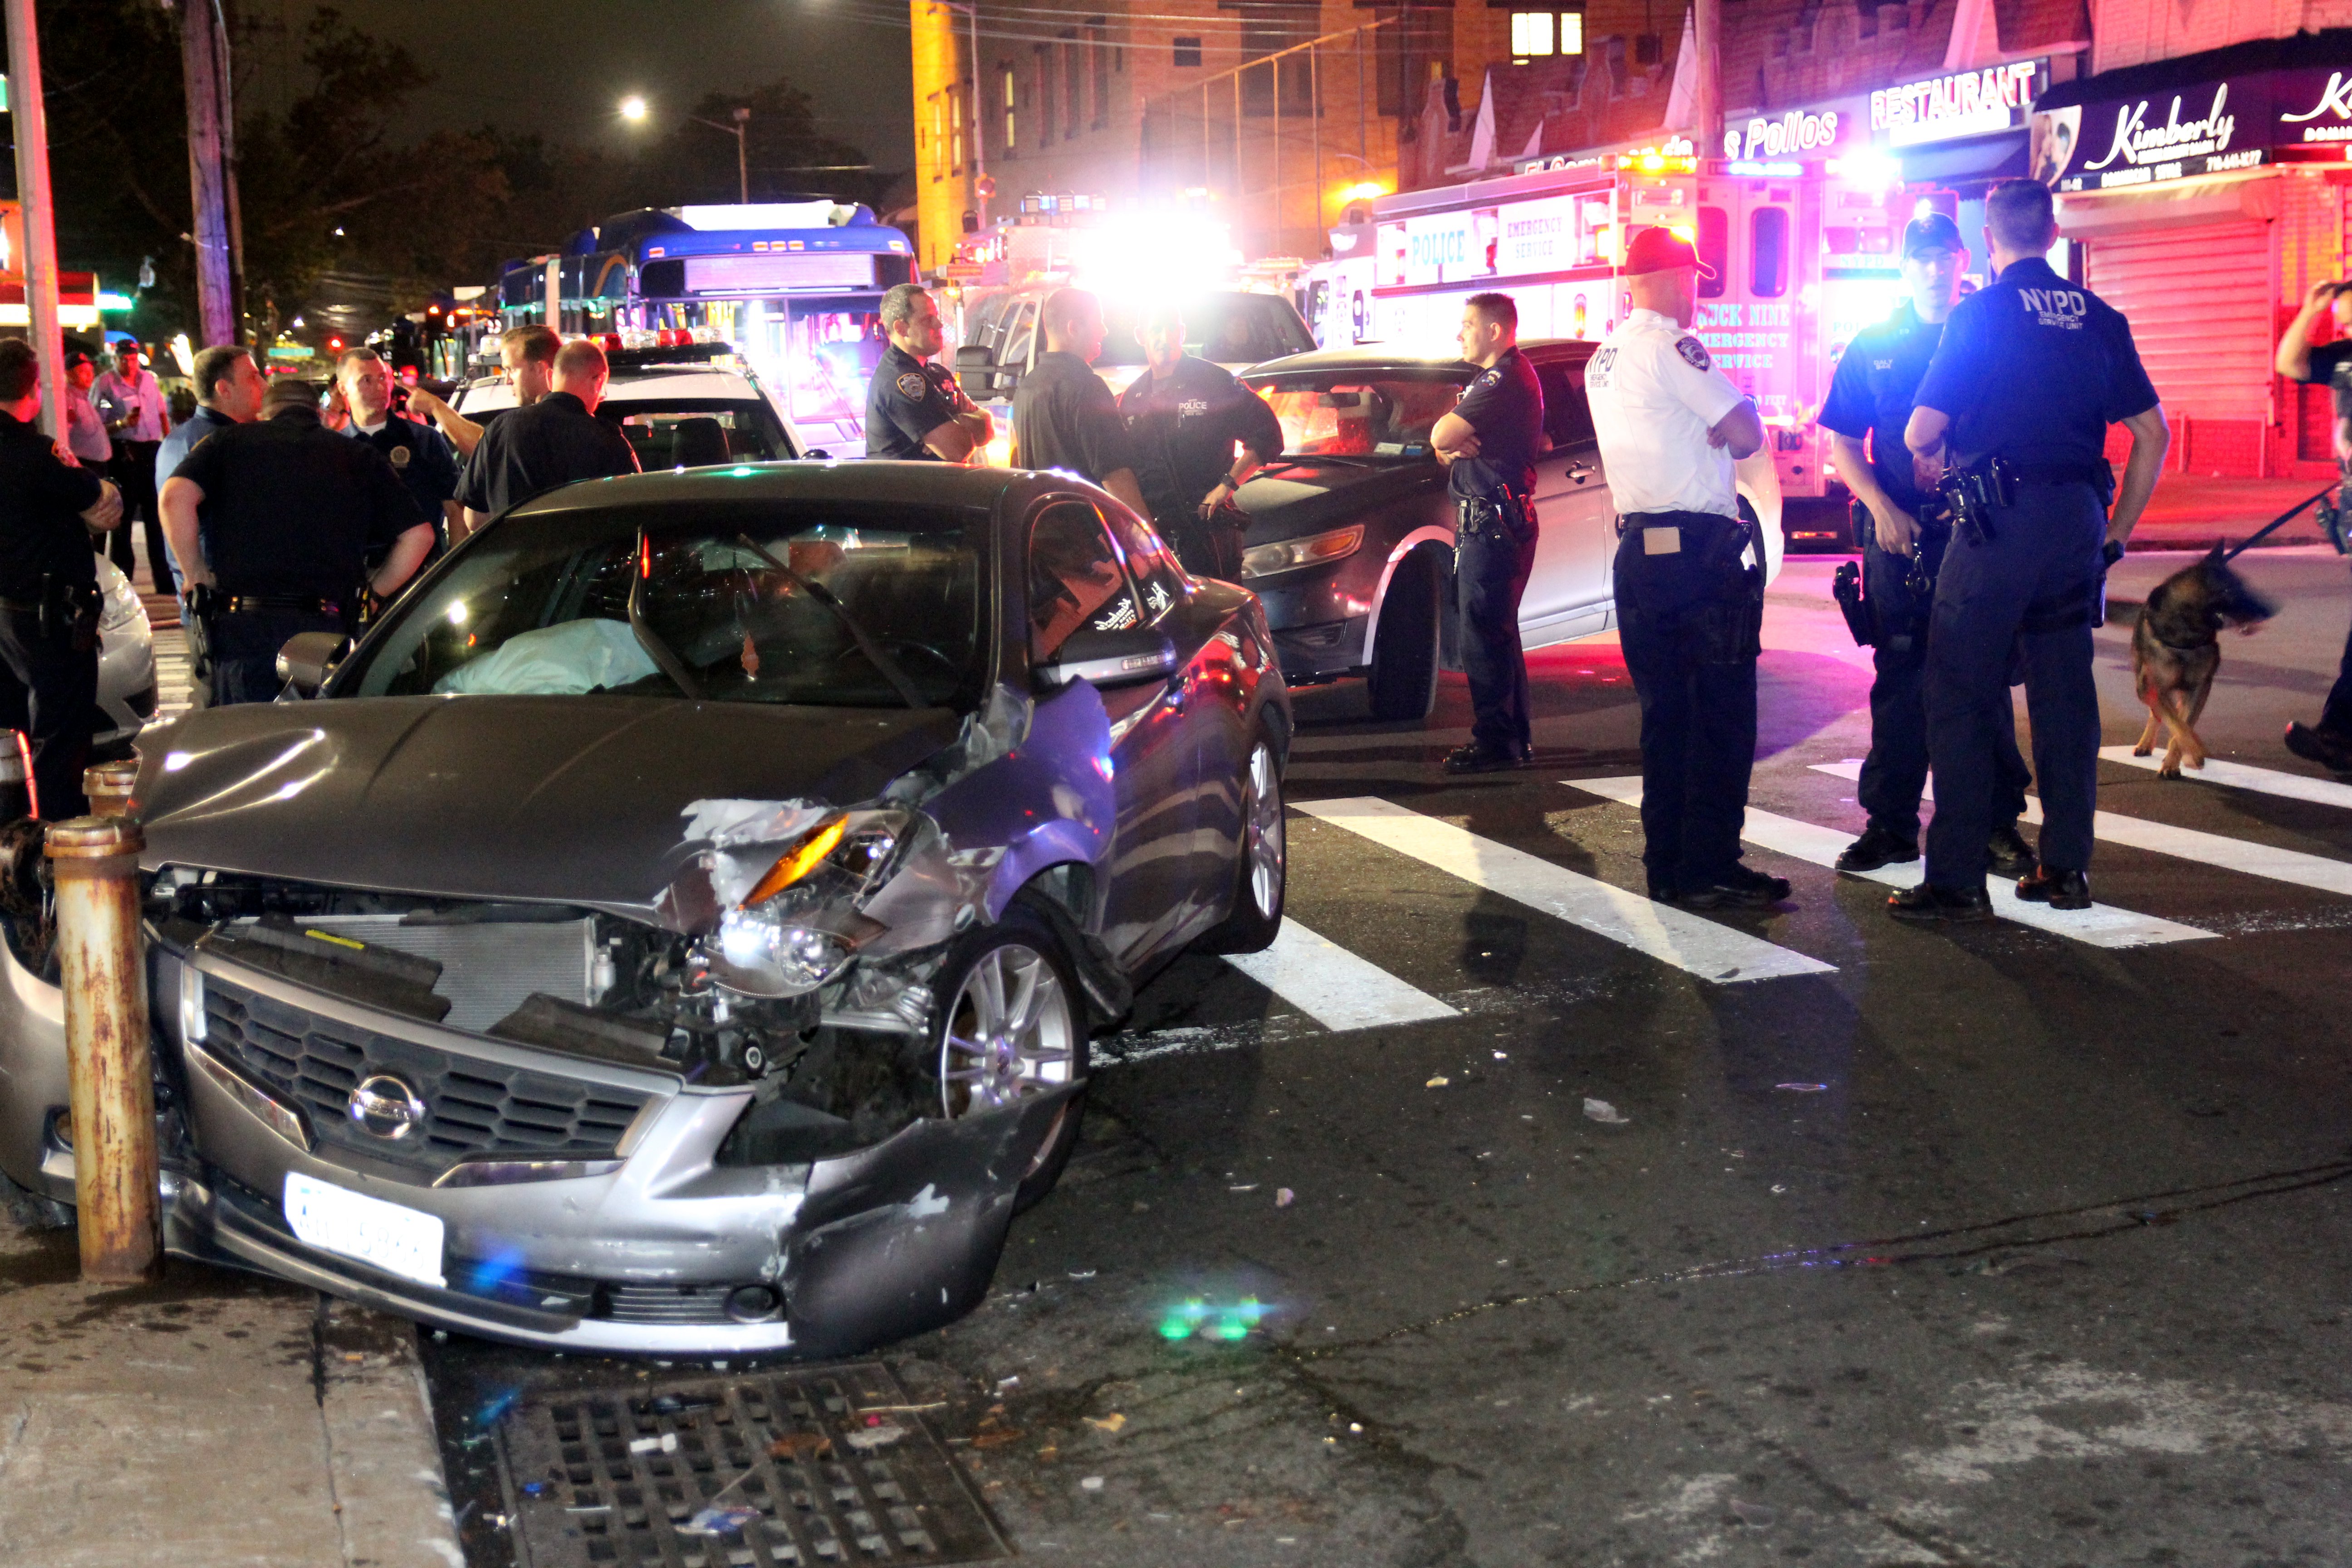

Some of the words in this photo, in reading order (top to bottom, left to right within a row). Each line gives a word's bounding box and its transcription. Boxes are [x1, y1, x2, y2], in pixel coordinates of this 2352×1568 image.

[1871, 61, 2035, 131] RESTAURANT
[1744, 111, 1838, 160] Pollos
[2084, 82, 2234, 170] Kimberly
[1507, 216, 1562, 239] EMERGENCY
[1411, 229, 1465, 266] POLICE
[1515, 240, 1554, 259] SERVICE
[1840, 255, 1884, 267] NYPD
[2018, 288, 2087, 316] NYPD
[1749, 304, 1790, 327] NINE
[2038, 318, 2065, 329] SERVE
[1697, 333, 1789, 348] MERGENCY
[1712, 354, 1773, 369] ERVICE
[1178, 401, 1207, 410] POLICE
